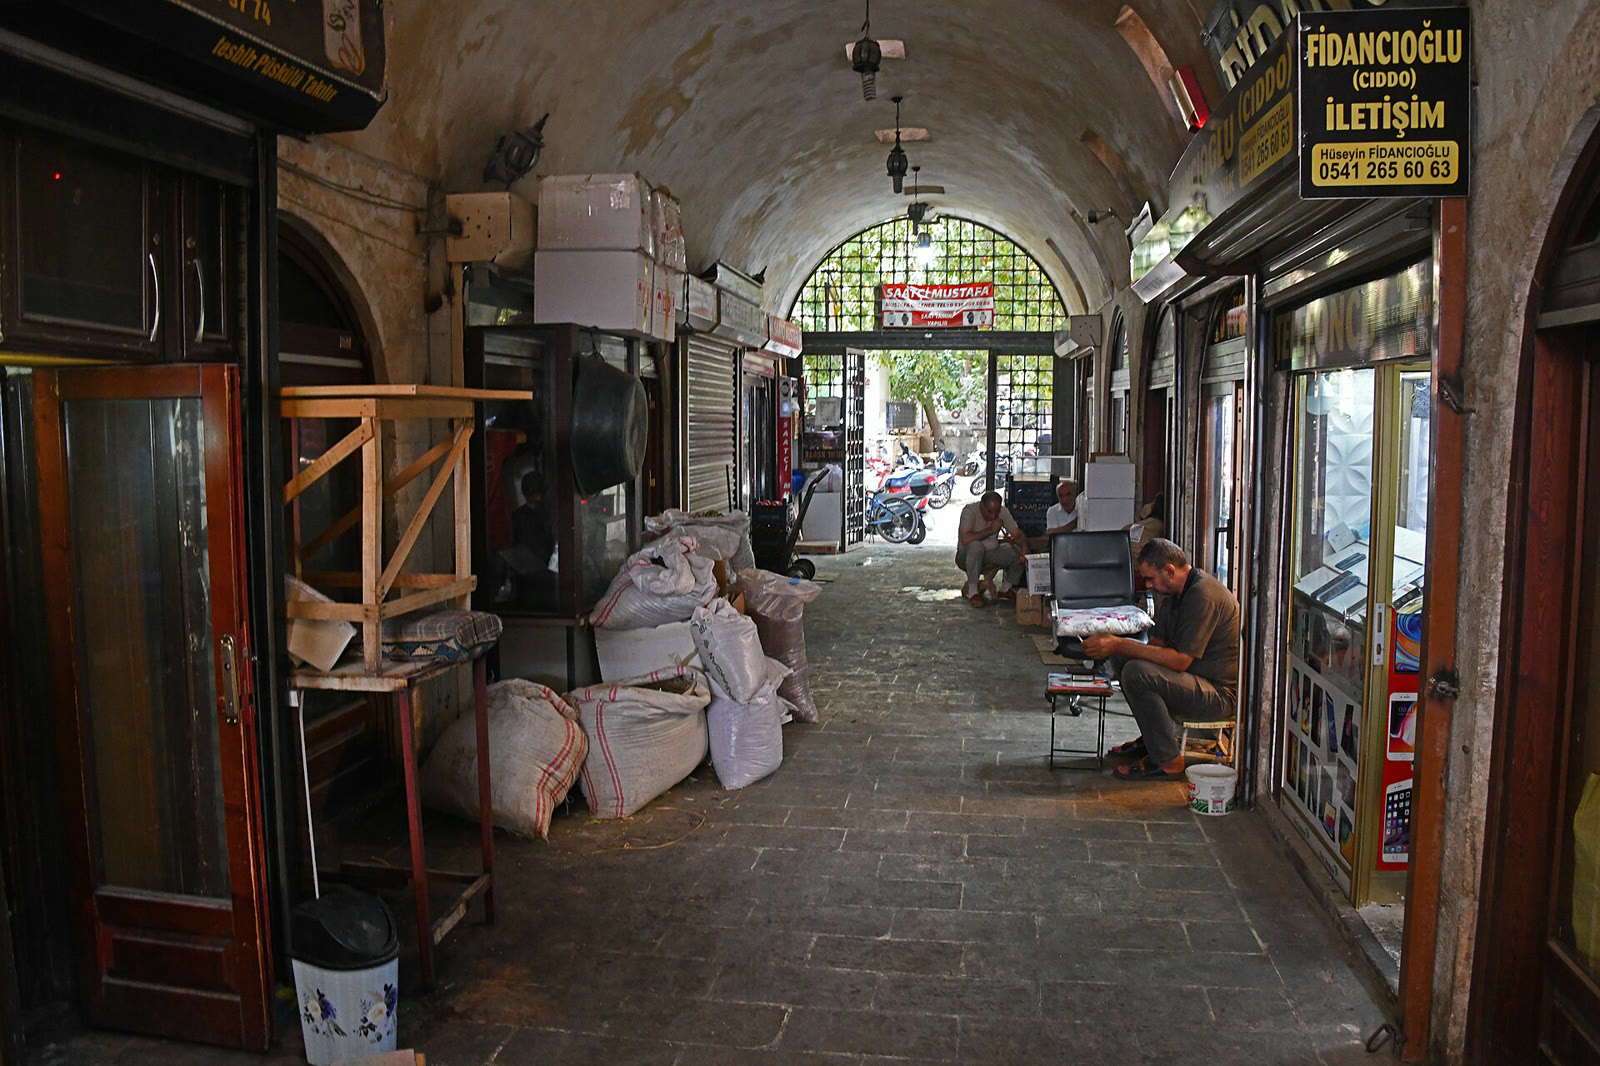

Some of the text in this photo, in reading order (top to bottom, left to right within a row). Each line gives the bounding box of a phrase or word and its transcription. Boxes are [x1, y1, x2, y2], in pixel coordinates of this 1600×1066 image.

[1307, 20, 1462, 67] FİDANCIOĞLU
[1238, 40, 1293, 132] (CIDDO)
[1353, 68, 1417, 91] (CIDDO)
[1326, 94, 1445, 138] İLETİŞİM
[1281, 121, 1290, 148] 63
[1320, 144, 1450, 161] Hüseyin FİDANCIOĞLU
[1319, 160, 1451, 180] 0541 265 60 63
[931, 286, 989, 298] MUSTAFA
